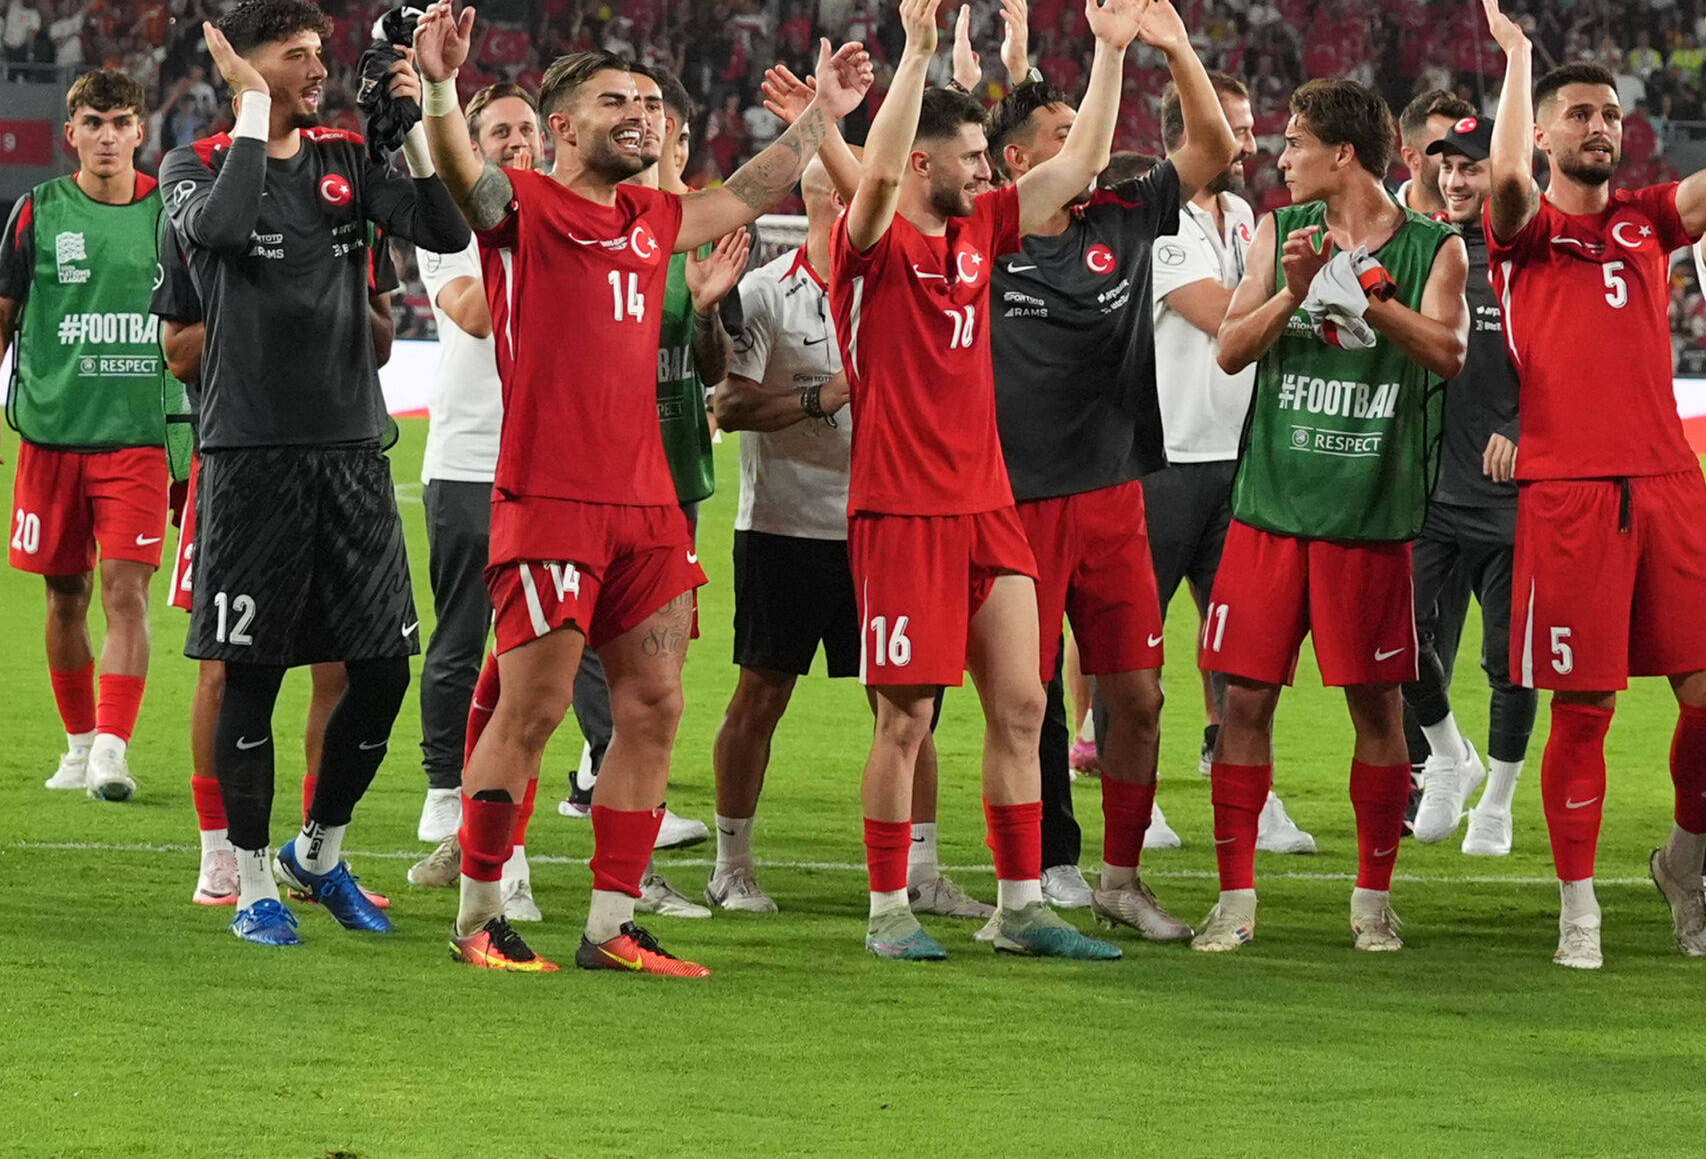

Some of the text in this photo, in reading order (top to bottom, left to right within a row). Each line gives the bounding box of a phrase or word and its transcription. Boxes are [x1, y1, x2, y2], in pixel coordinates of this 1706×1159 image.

[608, 269, 645, 322] 14
[1602, 260, 1628, 309] 5
[58, 313, 160, 345] #FOOTBA
[1014, 308, 1048, 318] RAMS
[100, 359, 158, 372] RESPECT
[1278, 373, 1400, 419] #FOOTBAL
[1314, 433, 1382, 453] RESPECT
[11, 508, 40, 554] 20
[214, 592, 256, 646] 12
[871, 616, 912, 667] 16
[1550, 627, 1573, 674] 5
